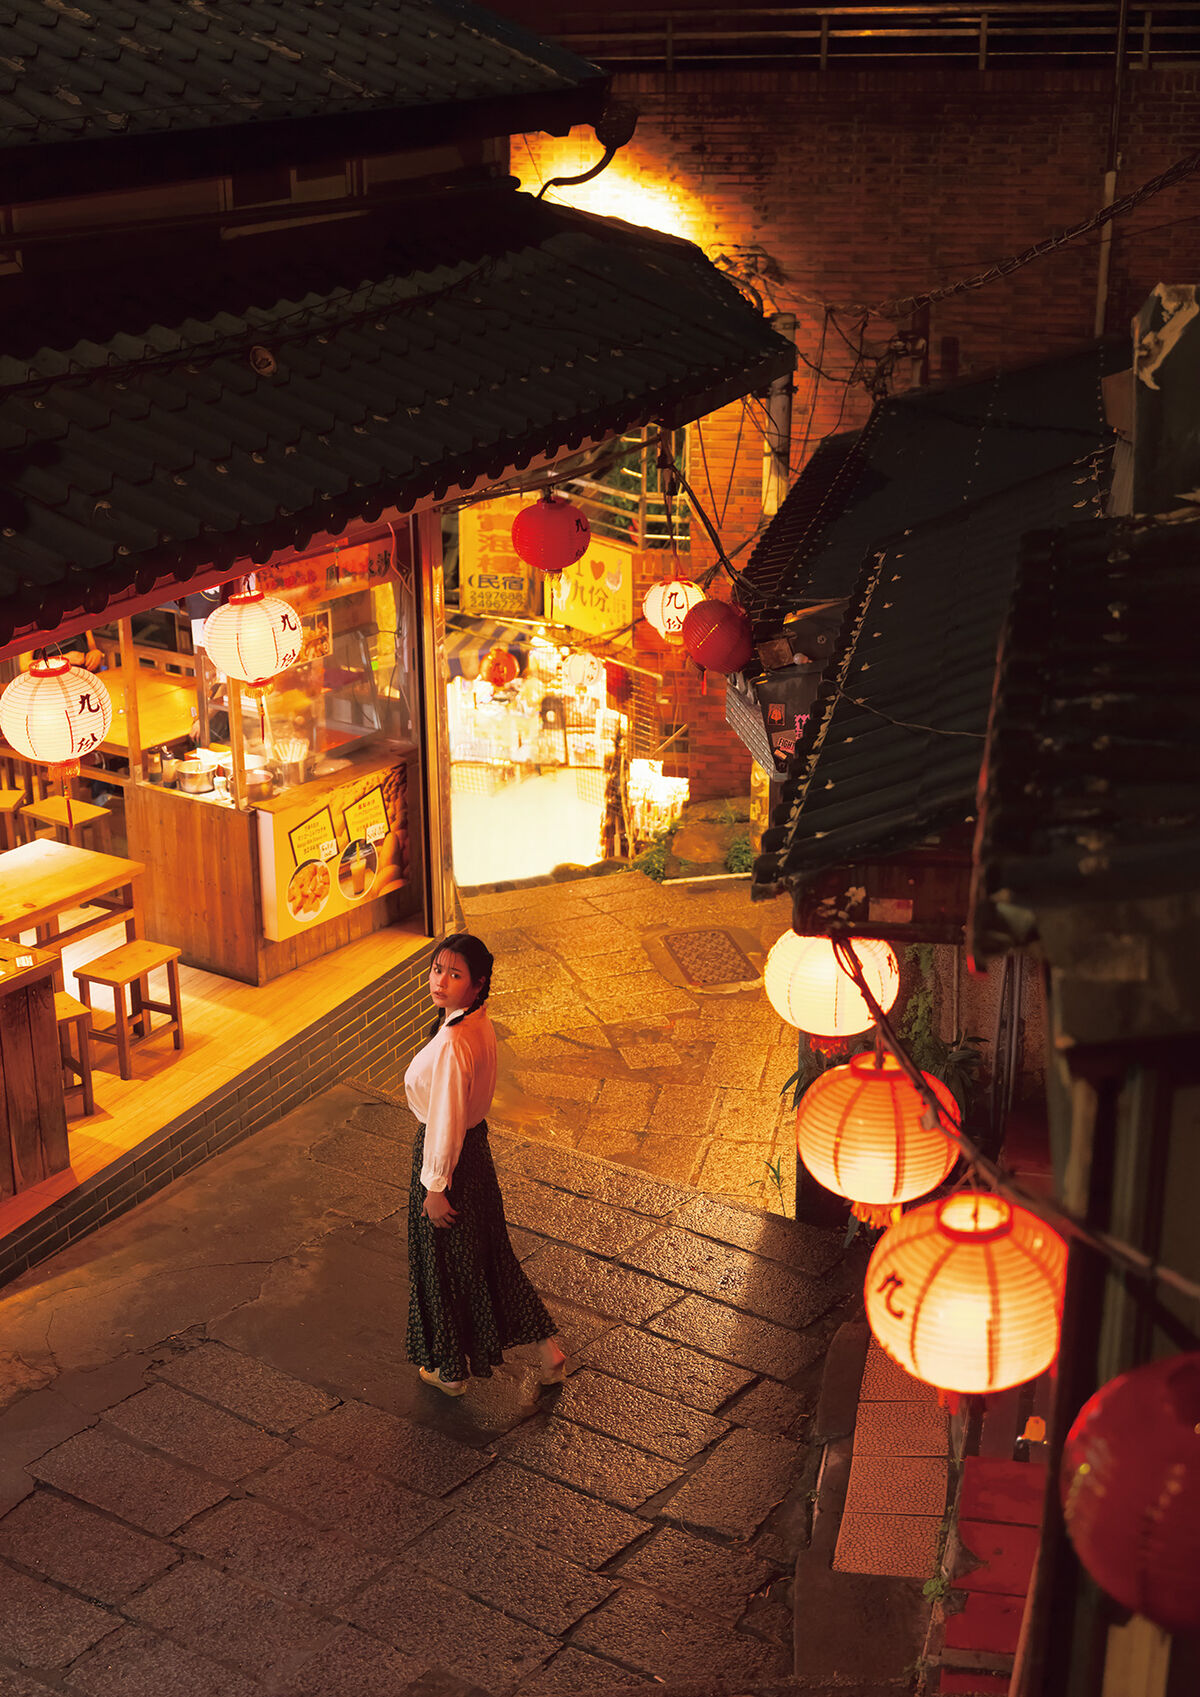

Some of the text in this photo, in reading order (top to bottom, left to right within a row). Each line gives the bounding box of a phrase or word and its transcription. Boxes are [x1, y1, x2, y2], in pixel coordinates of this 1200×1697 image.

[573, 579, 609, 613] 九份
[665, 592, 685, 630] 九份
[77, 693, 101, 753] 九份
